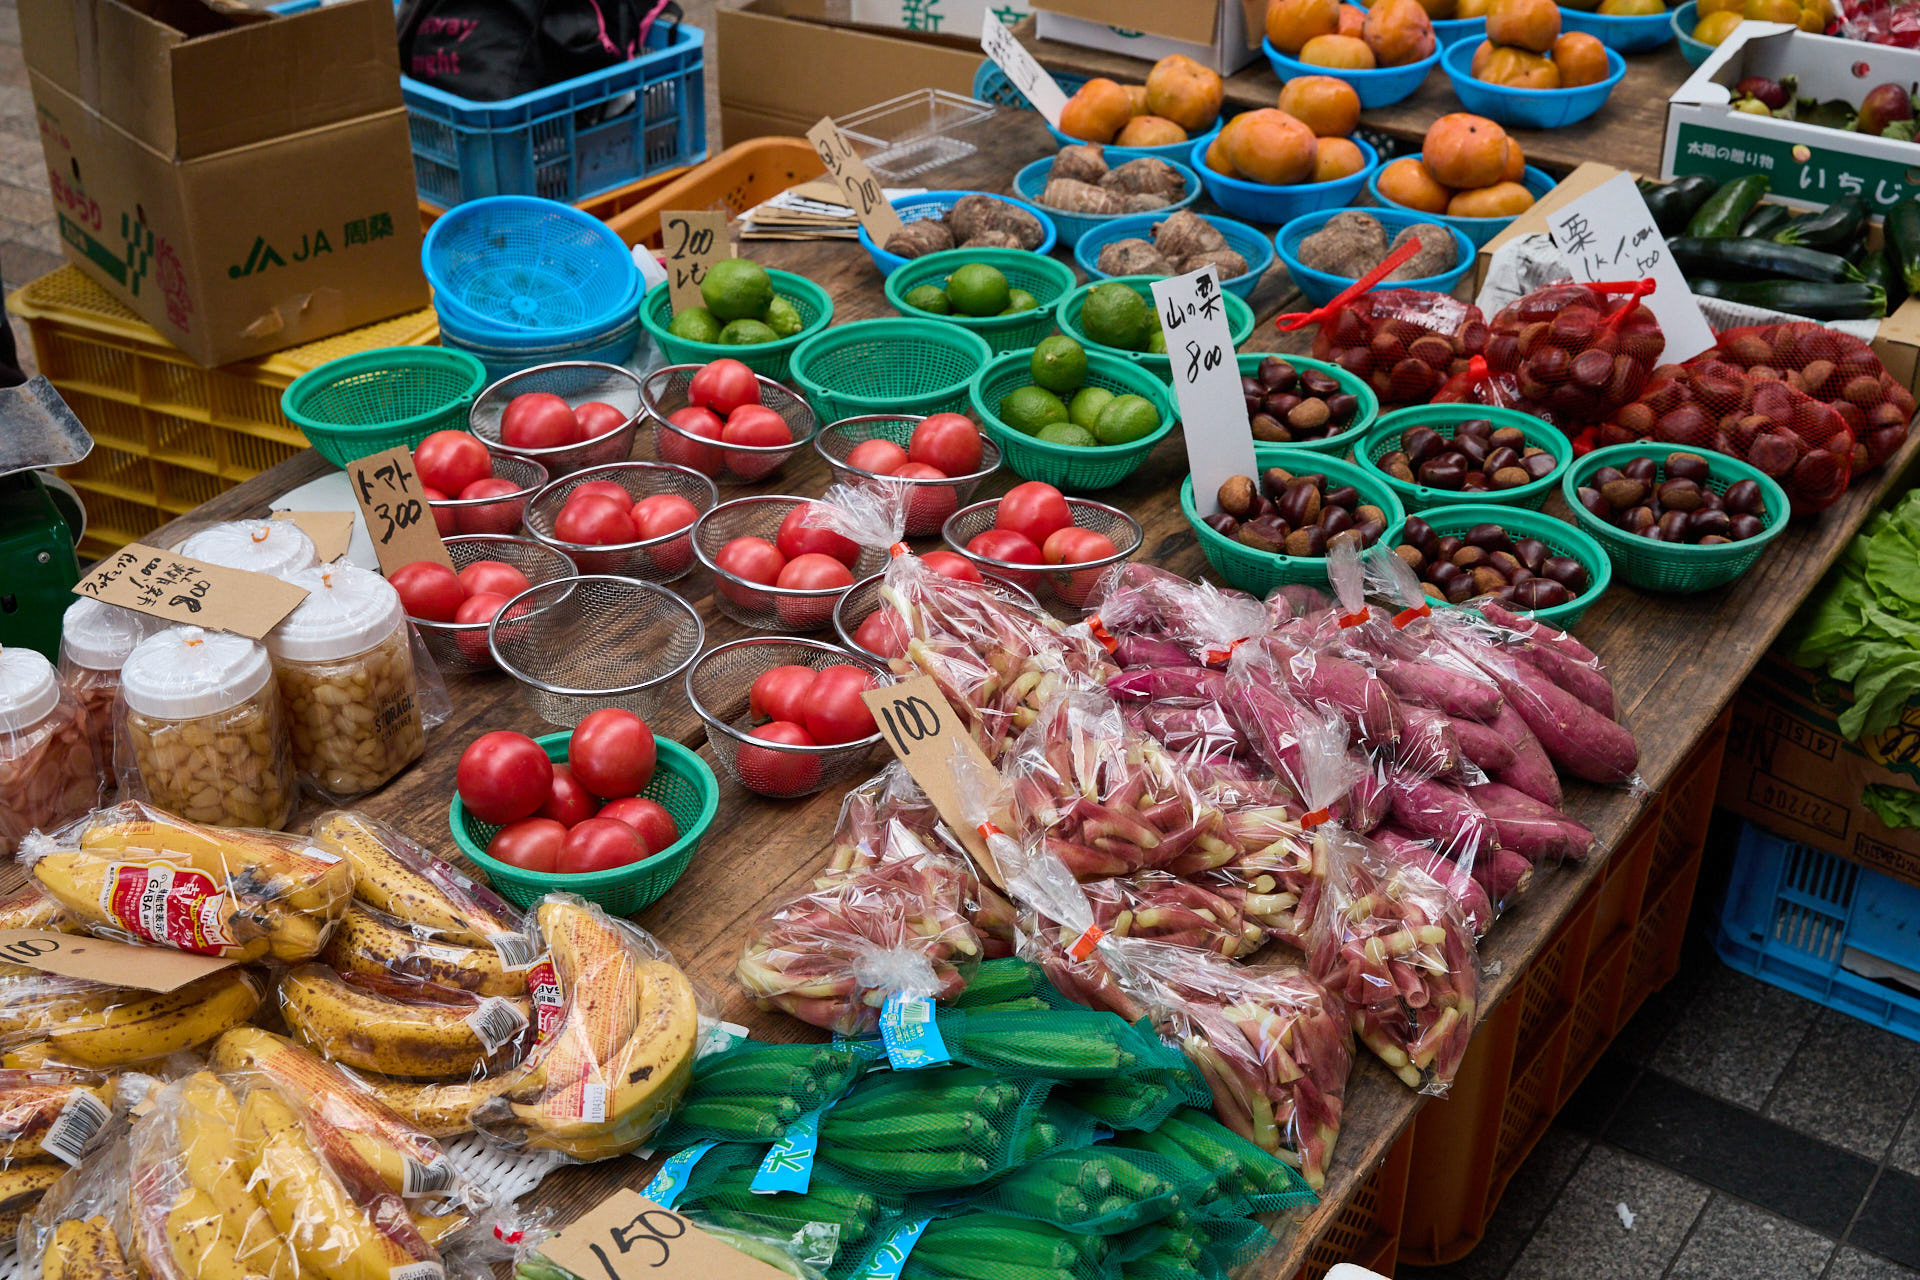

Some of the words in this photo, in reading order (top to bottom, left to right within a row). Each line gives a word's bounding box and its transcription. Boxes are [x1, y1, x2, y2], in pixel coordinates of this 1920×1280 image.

[1686, 141, 1774, 170] 太陽の贈り物
[292, 229, 333, 262] JA
[344, 212, 394, 248] 周桑
[668, 218, 714, 260] 200
[1560, 212, 1597, 254] 栗
[1166, 272, 1221, 330] 山の栗
[1185, 339, 1222, 384] 800
[357, 457, 413, 506] トマト
[374, 499, 423, 545] 300
[168, 579, 212, 614] 800
[880, 695, 941, 756] 100
[589, 1209, 686, 1280] 150
